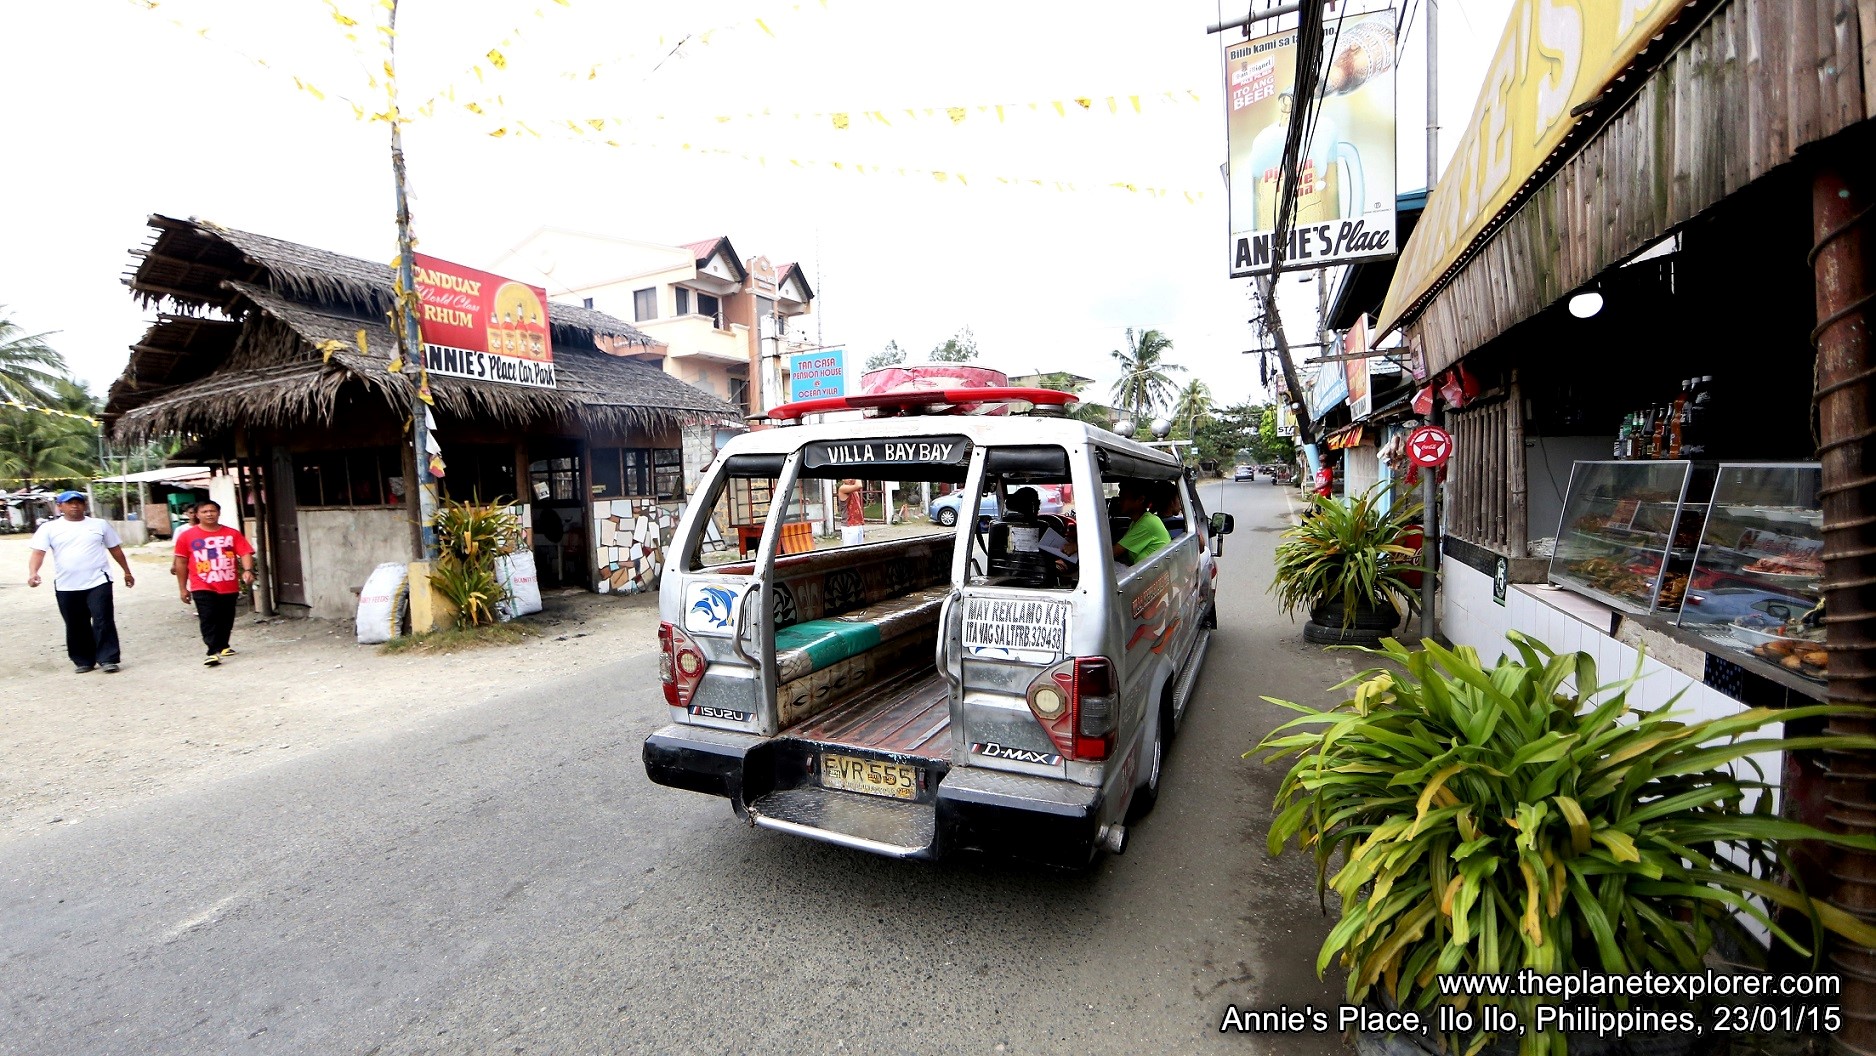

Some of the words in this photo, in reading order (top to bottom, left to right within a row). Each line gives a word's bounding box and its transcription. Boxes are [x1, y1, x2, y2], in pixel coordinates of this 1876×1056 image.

[1230, 47, 1252, 60] Bilib
[1253, 39, 1277, 53] kami
[1278, 36, 1291, 47] sa
[1233, 86, 1249, 99] ITO
[1252, 75, 1274, 92] ANG
[1233, 84, 1275, 111] BEER
[1333, 219, 1390, 256] Place
[424, 304, 473, 329] RHUM
[488, 355, 517, 381] Place
[518, 359, 533, 383] Car
[534, 362, 555, 386] Park
[793, 370, 818, 380] PENSION
[820, 367, 841, 377] HOUSE
[798, 360, 812, 370] TAN
[814, 357, 836, 369] CASA
[798, 389, 821, 398] OCEAN
[822, 387, 838, 396] VILLA
[827, 444, 875, 464] VILLA
[967, 600, 990, 621] MAY
[992, 602, 1043, 624] REKLAMO
[701, 706, 743, 720] ISUZU
[982, 742, 1049, 764] D-MAX
[869, 763, 912, 788] 555
